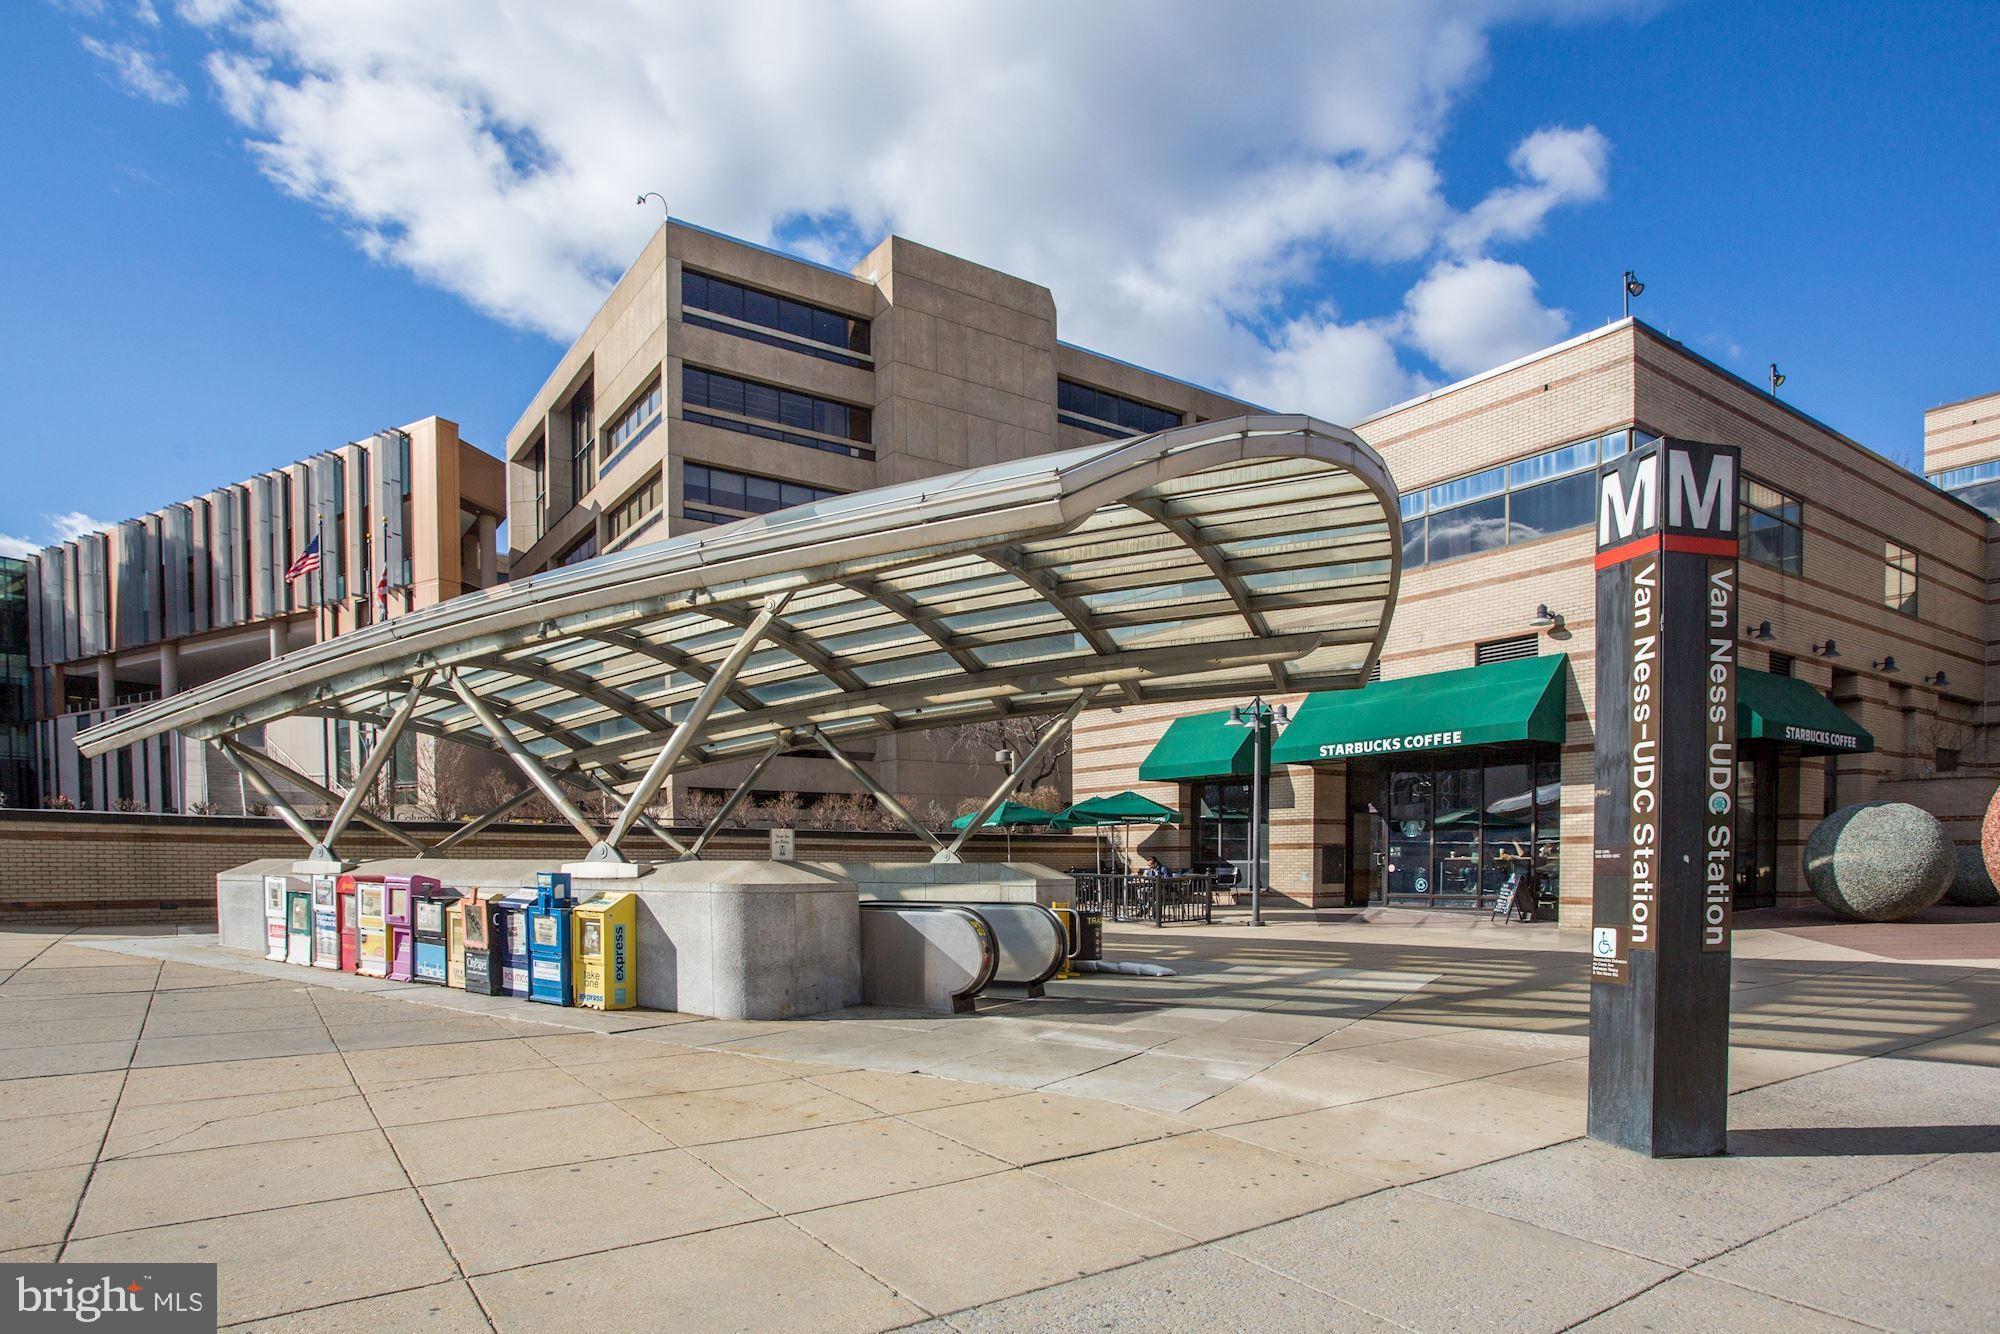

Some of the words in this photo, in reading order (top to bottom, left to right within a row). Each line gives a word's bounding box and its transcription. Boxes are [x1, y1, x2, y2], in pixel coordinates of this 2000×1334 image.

[1600, 455, 1657, 547] M
[1669, 450, 1732, 532] M
[1634, 562, 1656, 628] Van
[1710, 568, 1733, 628] Van
[1319, 737, 1401, 757] STARBUCKS
[1404, 731, 1462, 749] COFFEE
[1785, 726, 1830, 745] STARBUCKS
[1830, 733, 1857, 748] COFFEE
[1631, 824, 1655, 943] Station
[1706, 825, 1731, 945] Station
[615, 925, 624, 981] express
[579, 993, 604, 1002] express
[584, 979, 600, 988] one
